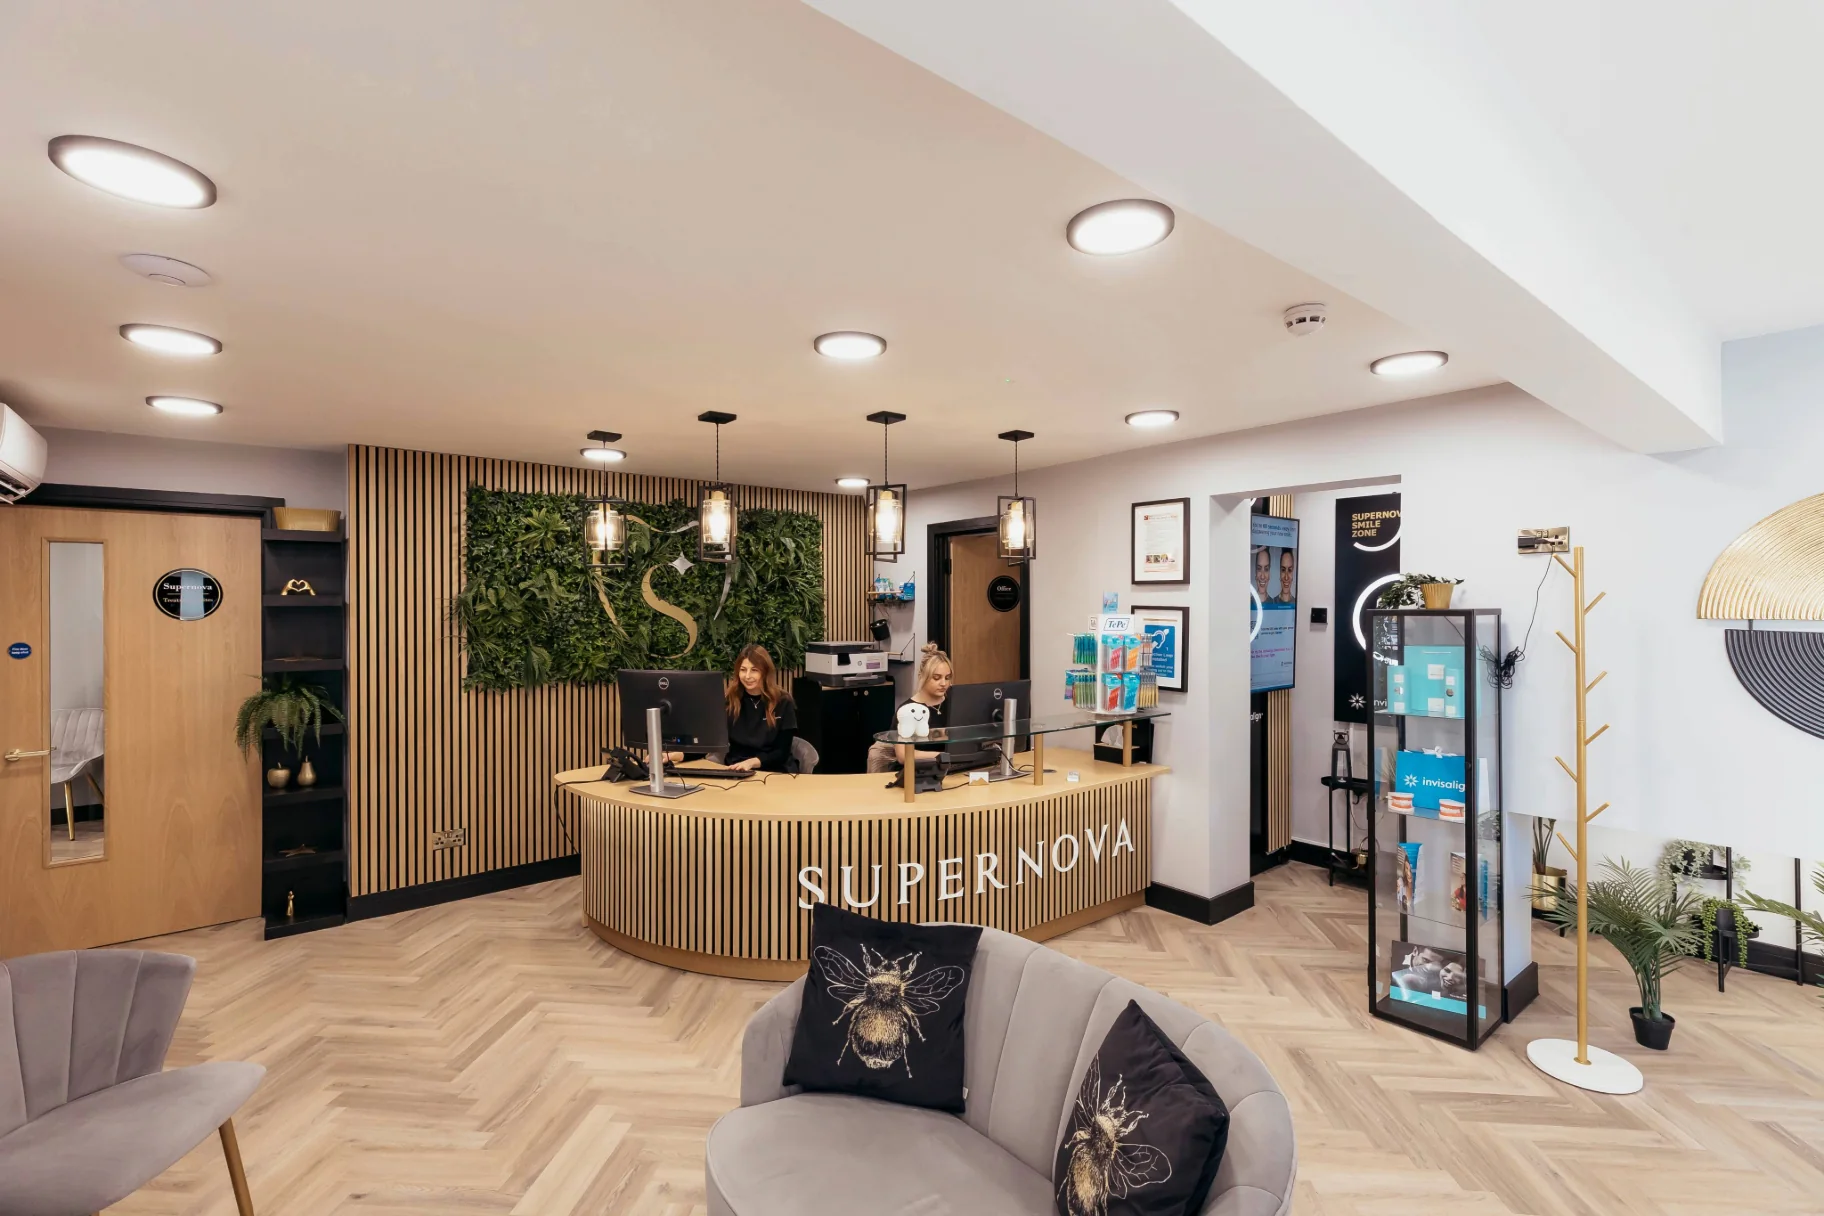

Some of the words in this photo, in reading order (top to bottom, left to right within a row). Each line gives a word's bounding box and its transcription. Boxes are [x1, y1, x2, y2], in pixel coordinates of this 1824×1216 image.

[1351, 510, 1401, 520] SUPERNOV
[1352, 520, 1381, 529] SMILE
[1352, 529, 1377, 538] ZONE
[163, 582, 213, 592] Supernova
[1108, 620, 1126, 629] TePe
[1422, 777, 1466, 793] invisalig
[798, 817, 1135, 910] SUPERNOVA
